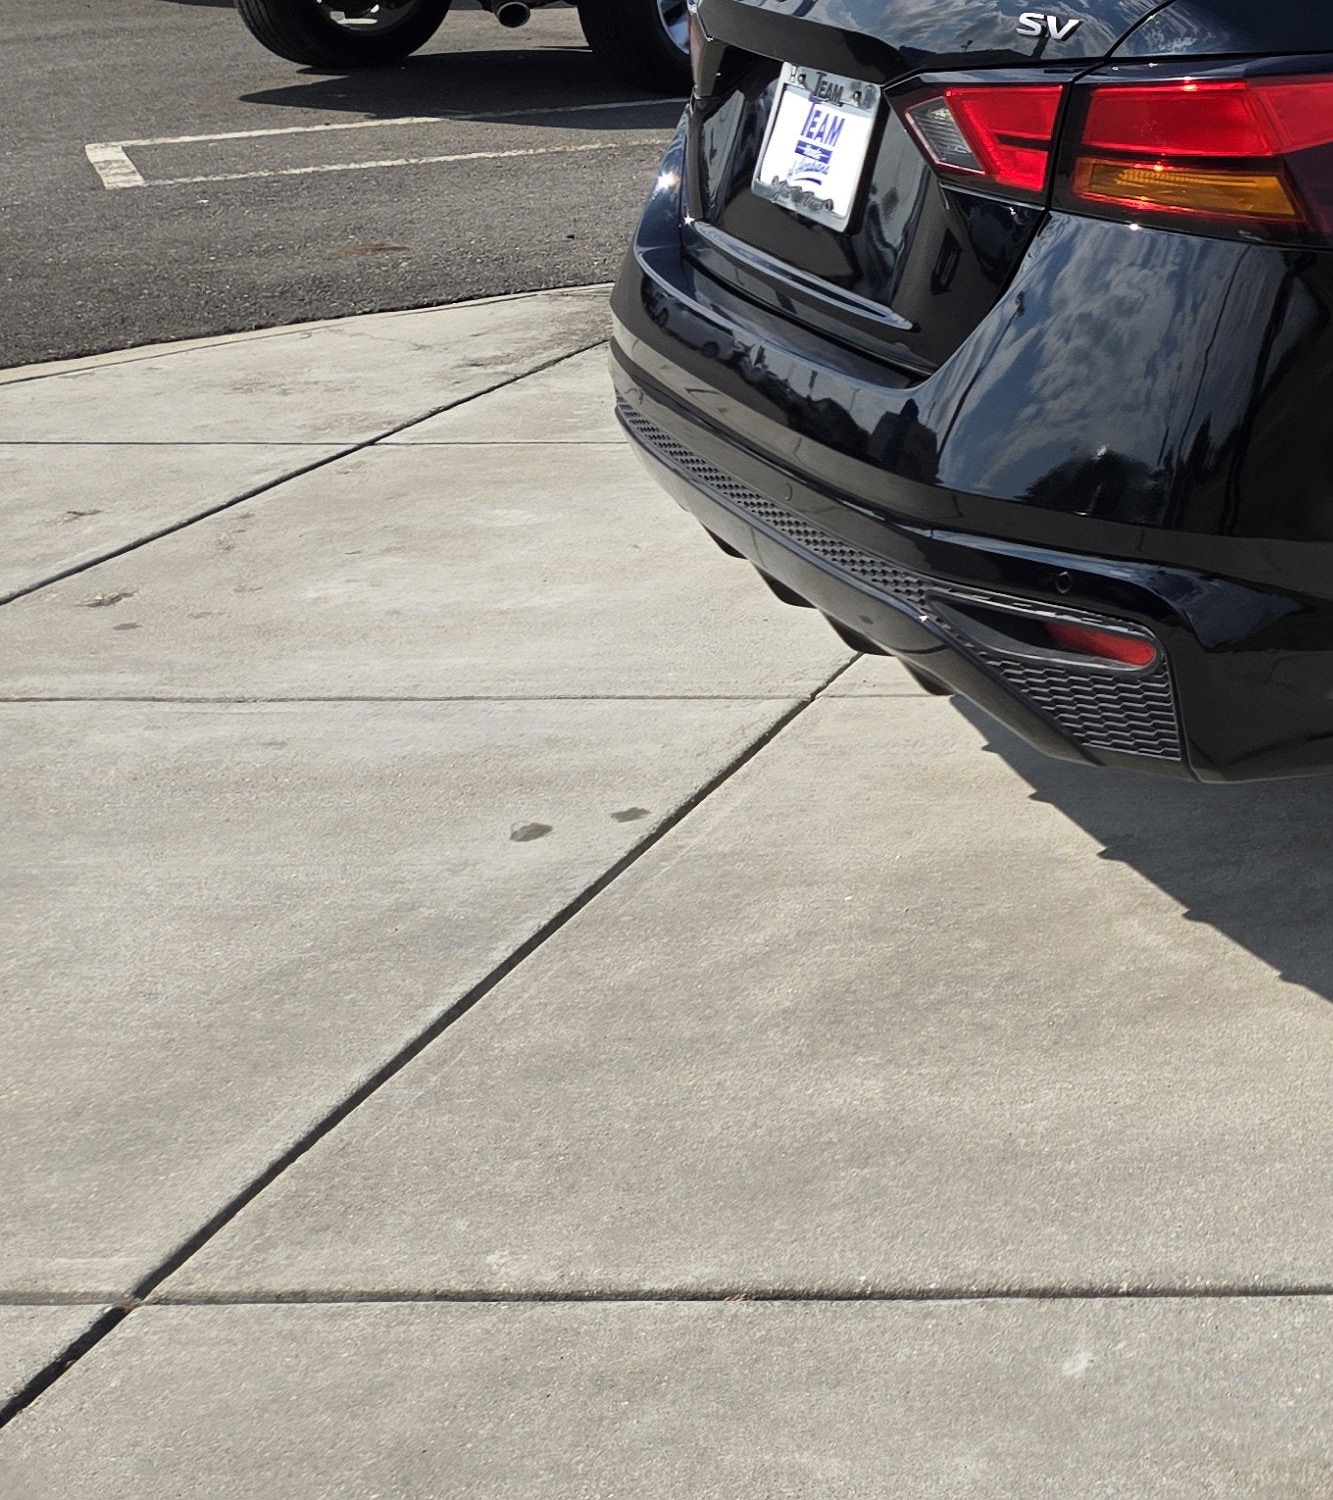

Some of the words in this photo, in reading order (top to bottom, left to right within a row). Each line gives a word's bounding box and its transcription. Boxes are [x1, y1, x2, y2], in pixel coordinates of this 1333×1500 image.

[1016, 12, 1081, 41] SV
[812, 71, 844, 105] TEAM
[801, 96, 846, 148] TEAM
